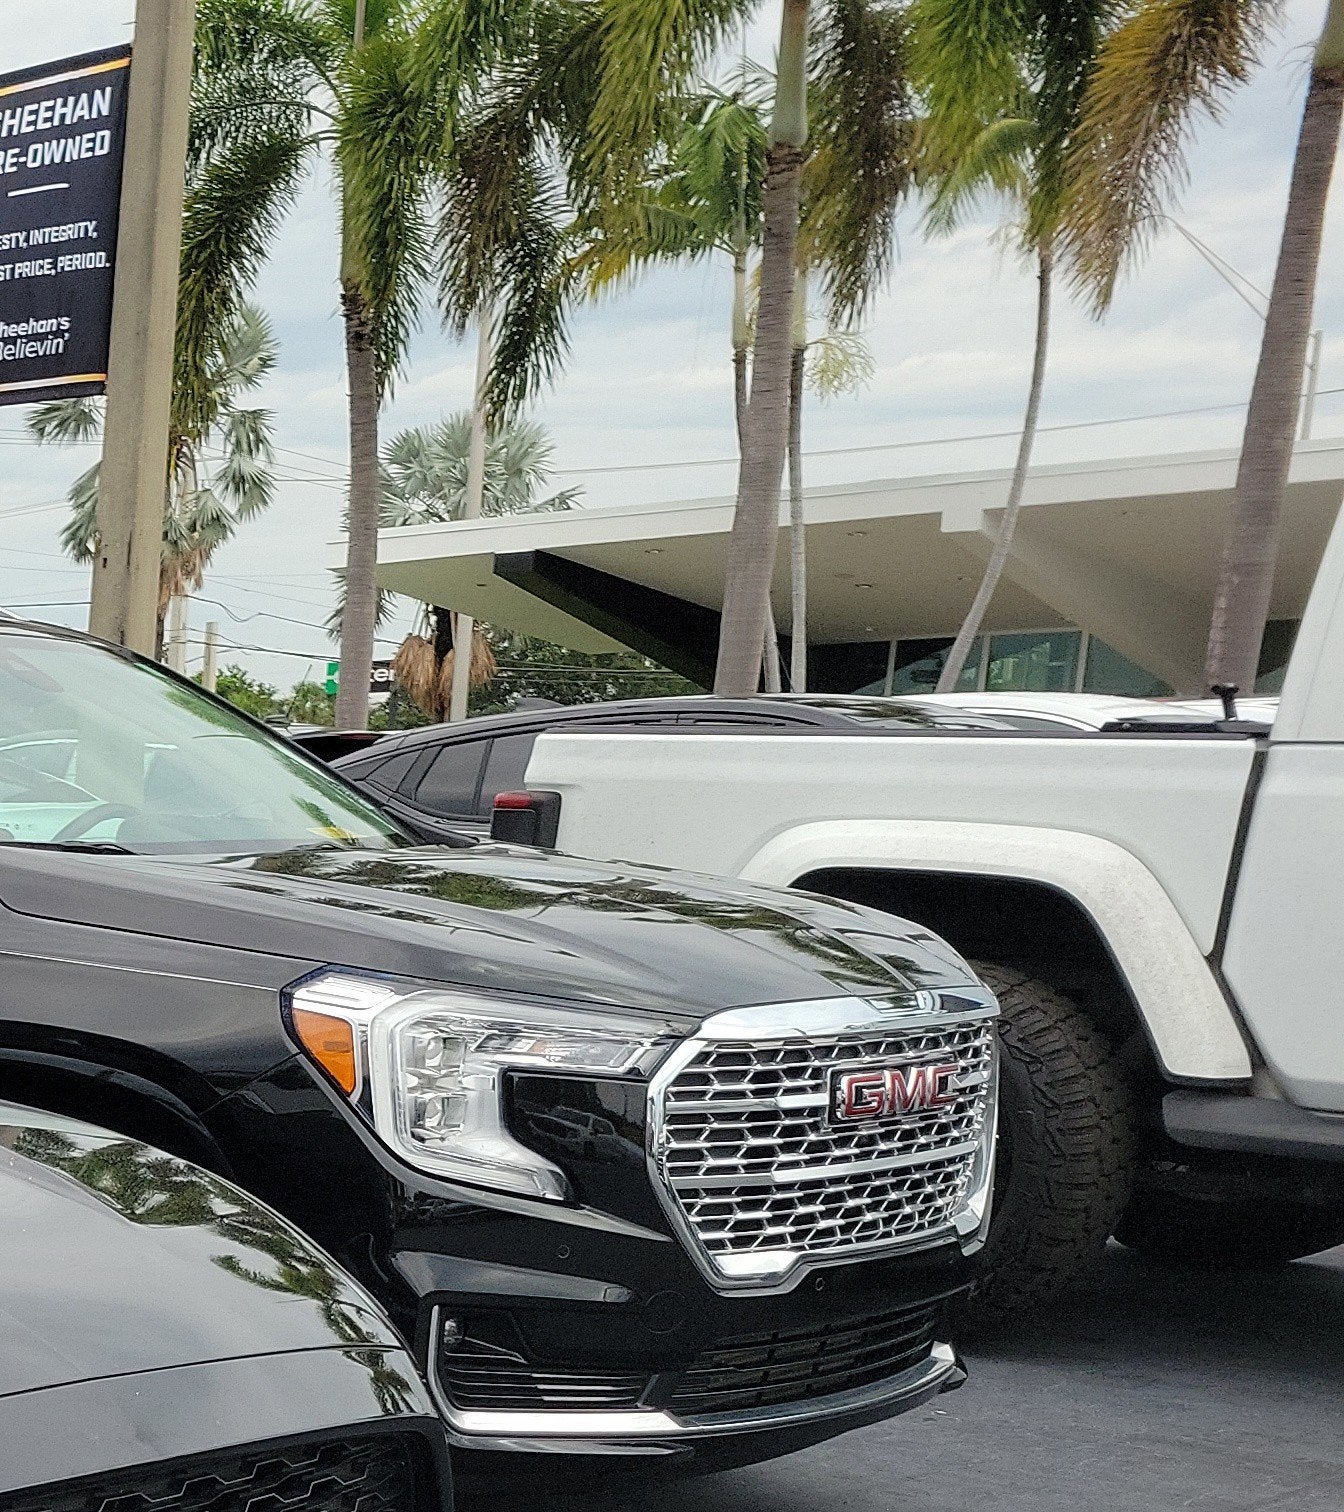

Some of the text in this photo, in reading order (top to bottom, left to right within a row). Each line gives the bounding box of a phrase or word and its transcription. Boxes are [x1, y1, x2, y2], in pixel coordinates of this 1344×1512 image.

[29, 221, 98, 246] INTEGRITY,
[14, 258, 56, 277] PRICE,
[57, 252, 111, 272] PERIOD.
[841, 1065, 961, 1120] GMC
